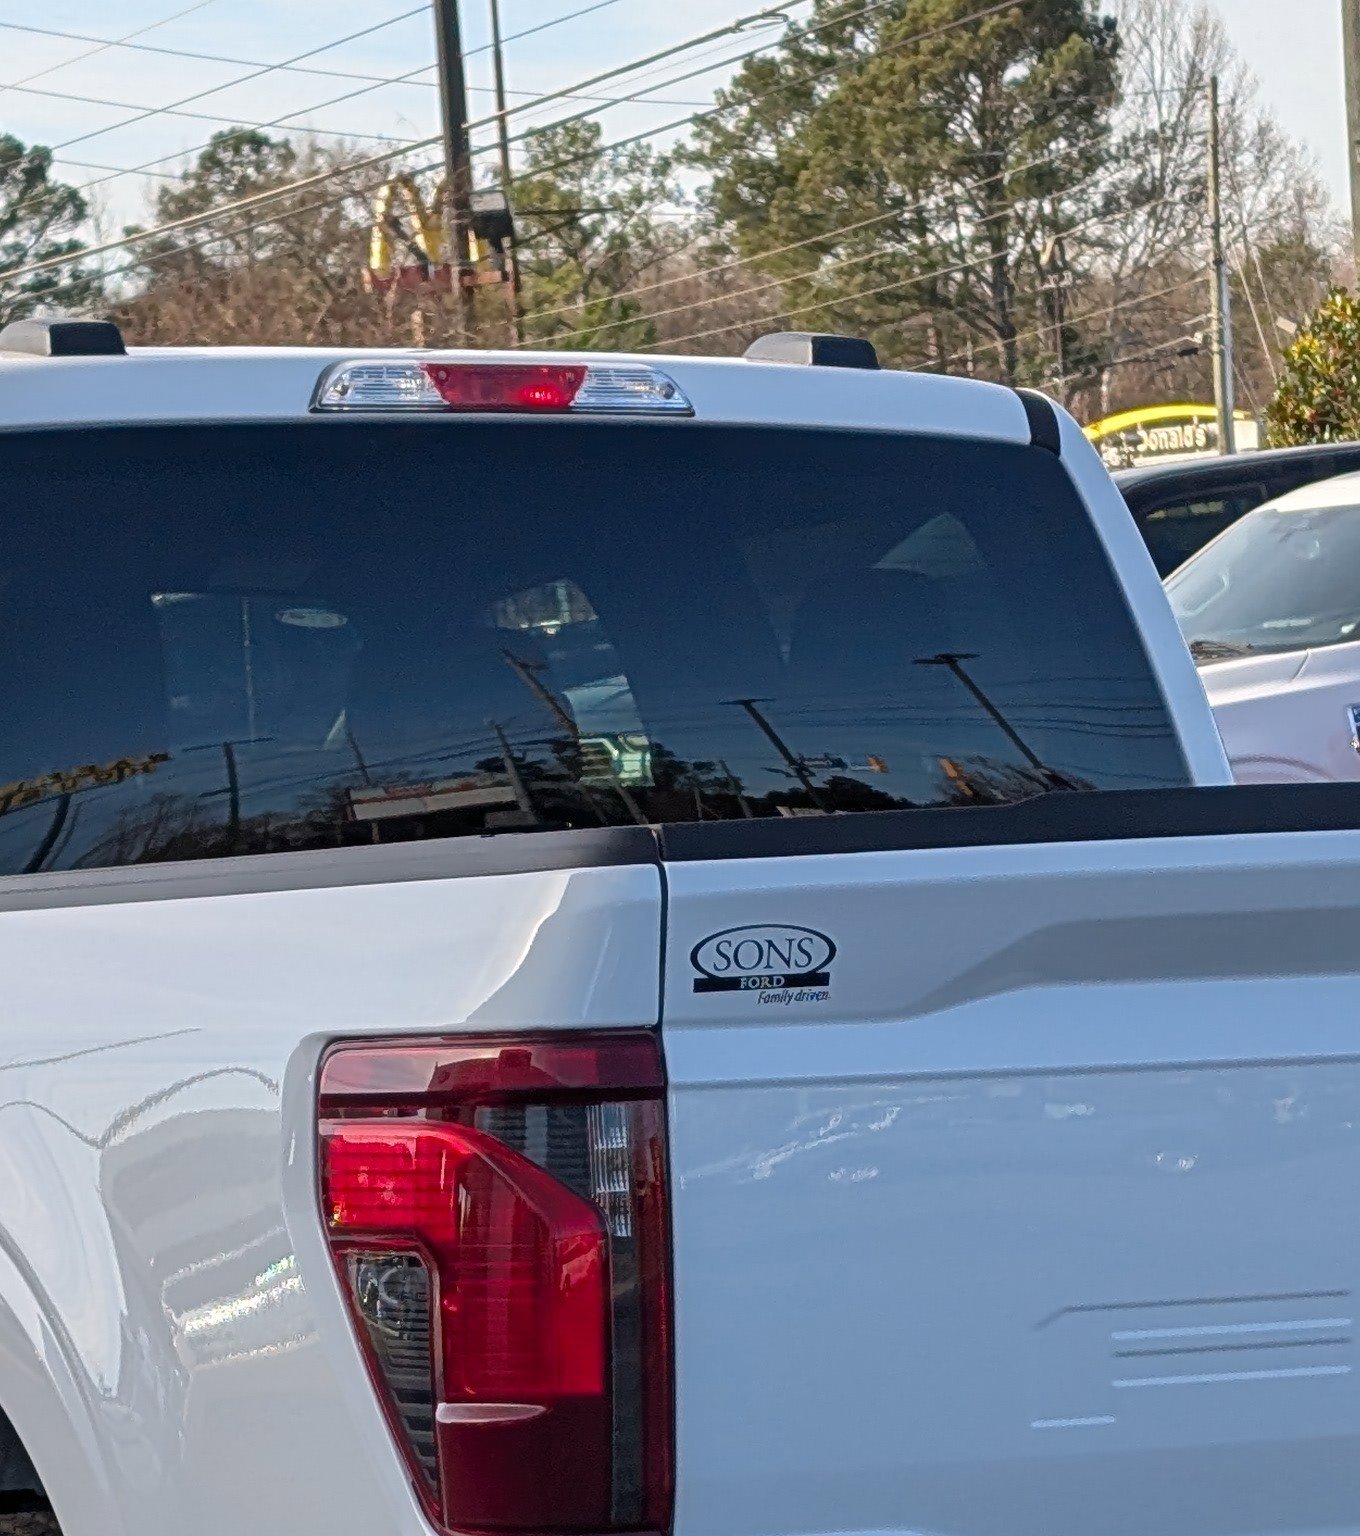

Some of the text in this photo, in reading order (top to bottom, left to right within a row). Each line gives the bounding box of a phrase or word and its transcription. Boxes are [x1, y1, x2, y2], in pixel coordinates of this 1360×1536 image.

[713, 937, 813, 972] SONS
[740, 975, 785, 989] FORD
[757, 989, 793, 1006] Family
